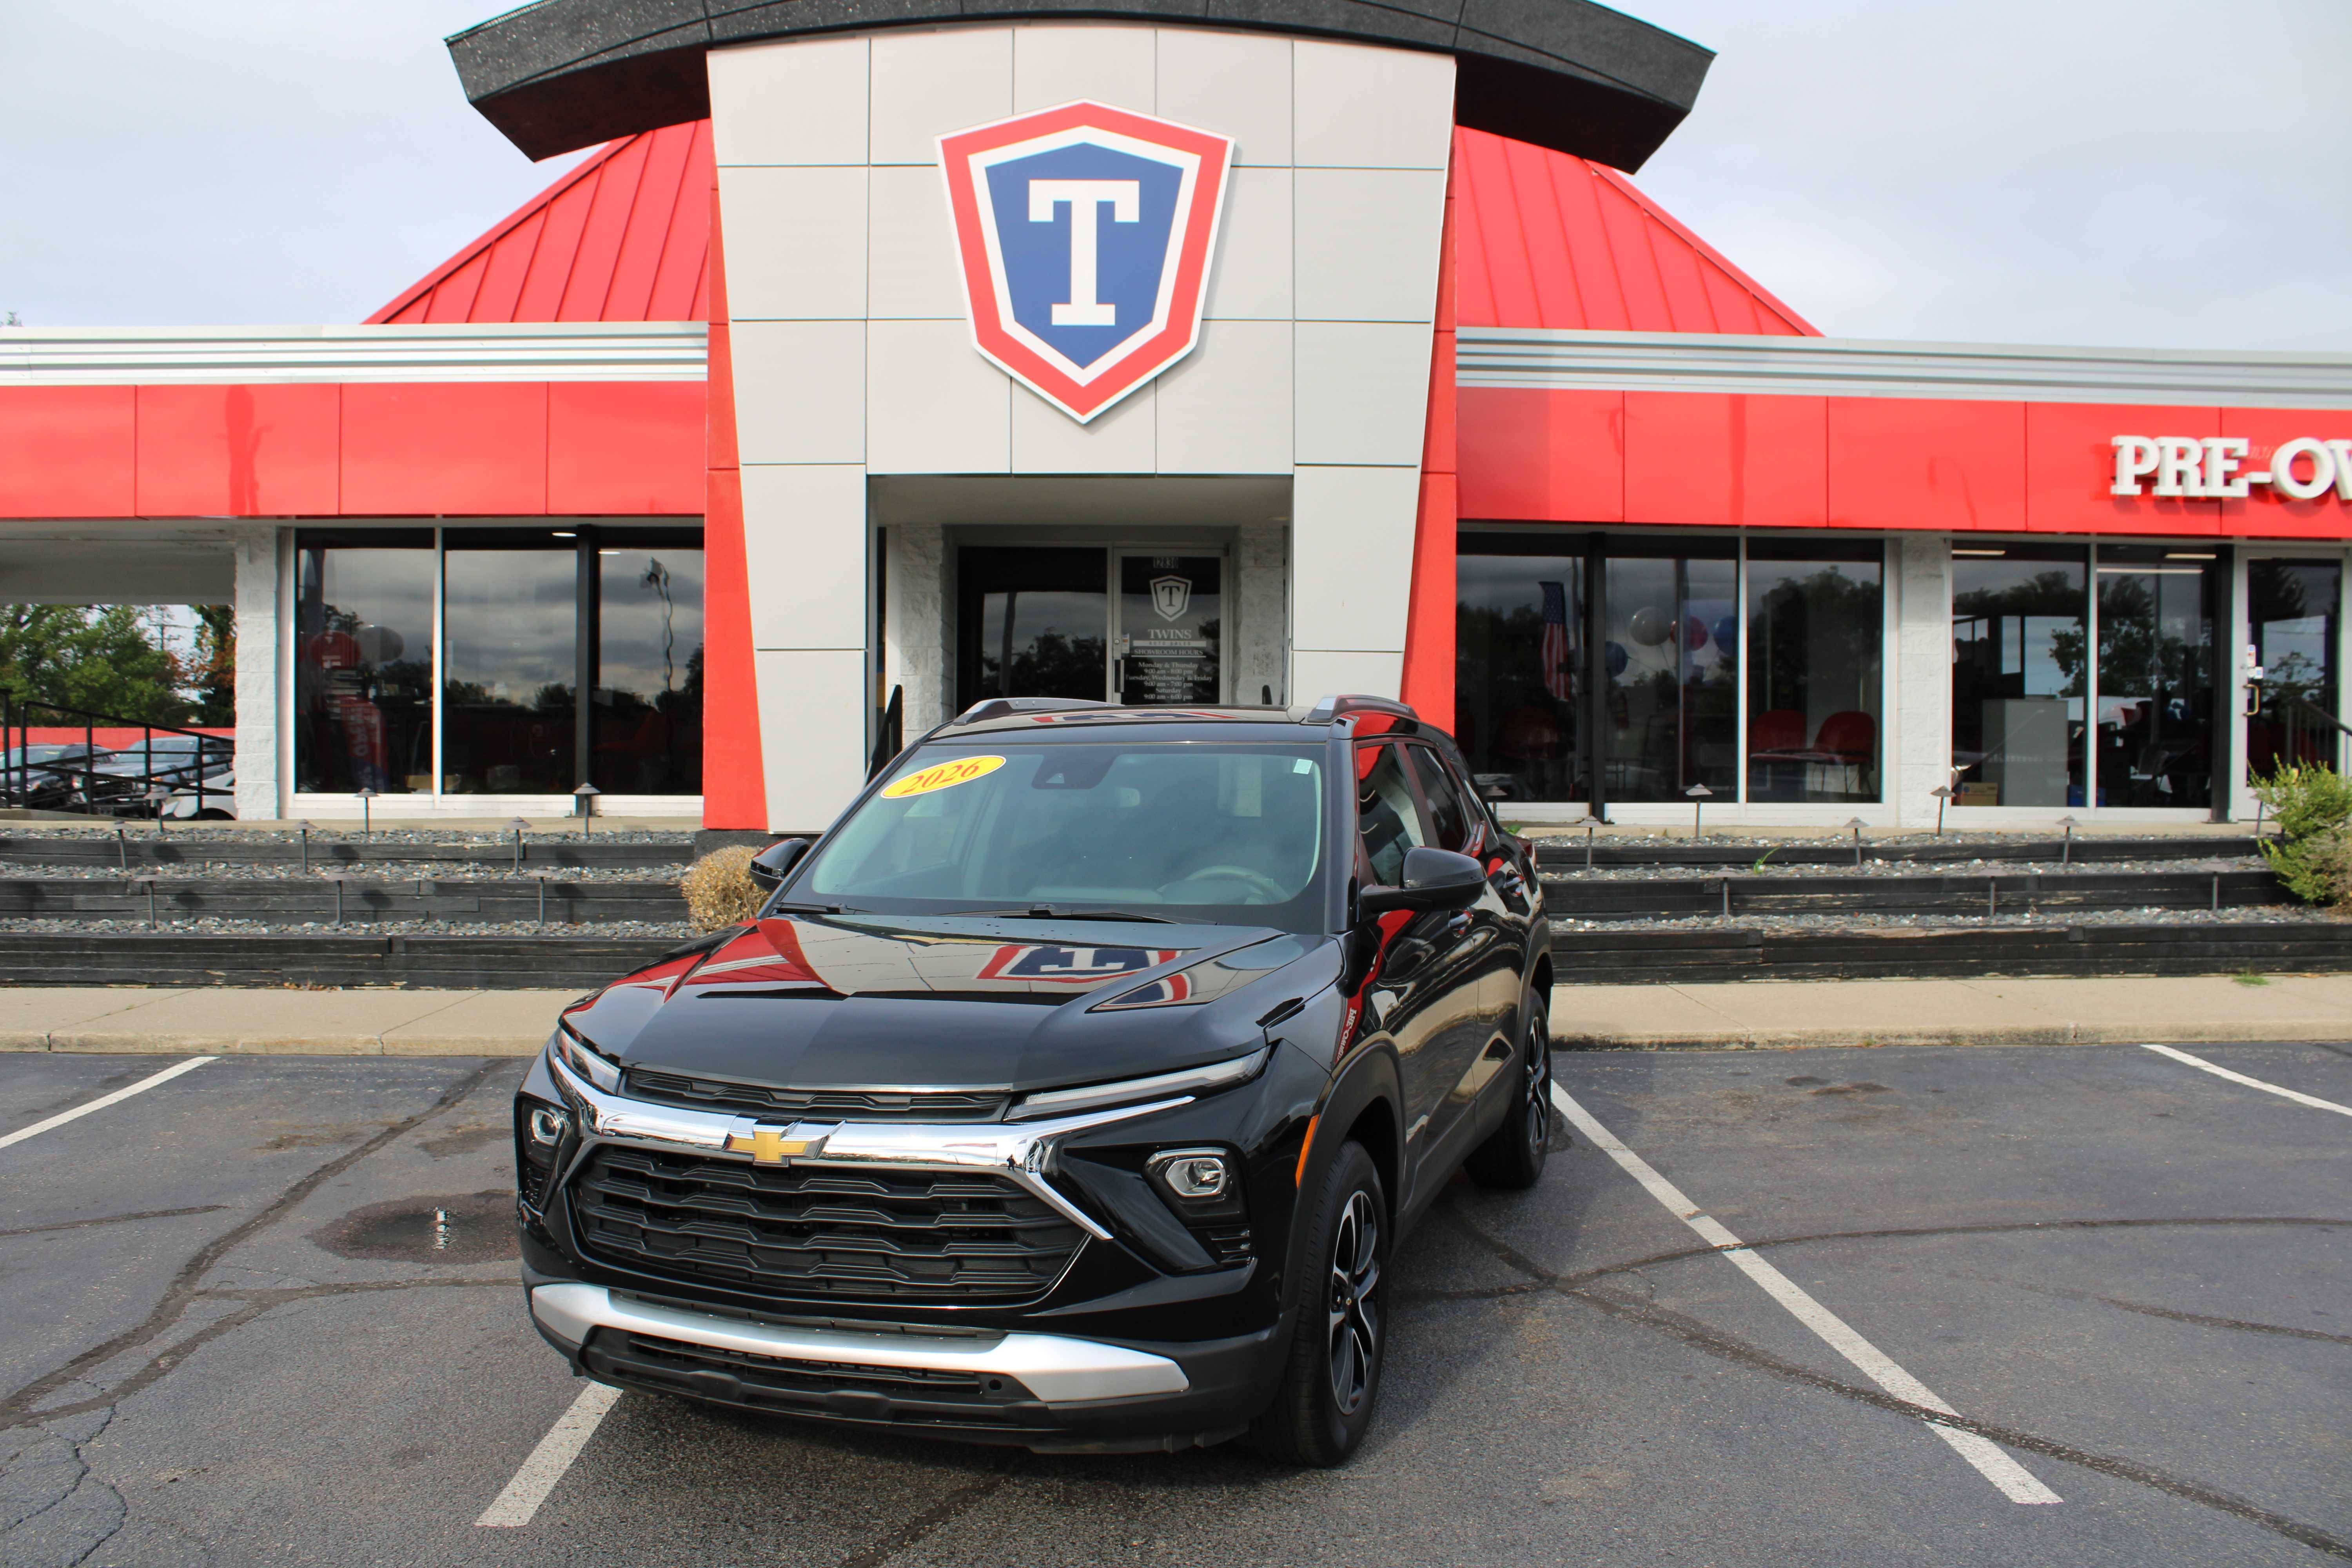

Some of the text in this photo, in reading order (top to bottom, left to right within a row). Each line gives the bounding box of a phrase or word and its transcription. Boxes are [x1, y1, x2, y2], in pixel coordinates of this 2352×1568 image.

[1029, 180, 1140, 325] T
[1161, 586, 1180, 606] T
[1148, 629, 1192, 639] TWINS
[899, 758, 987, 795] 2026
